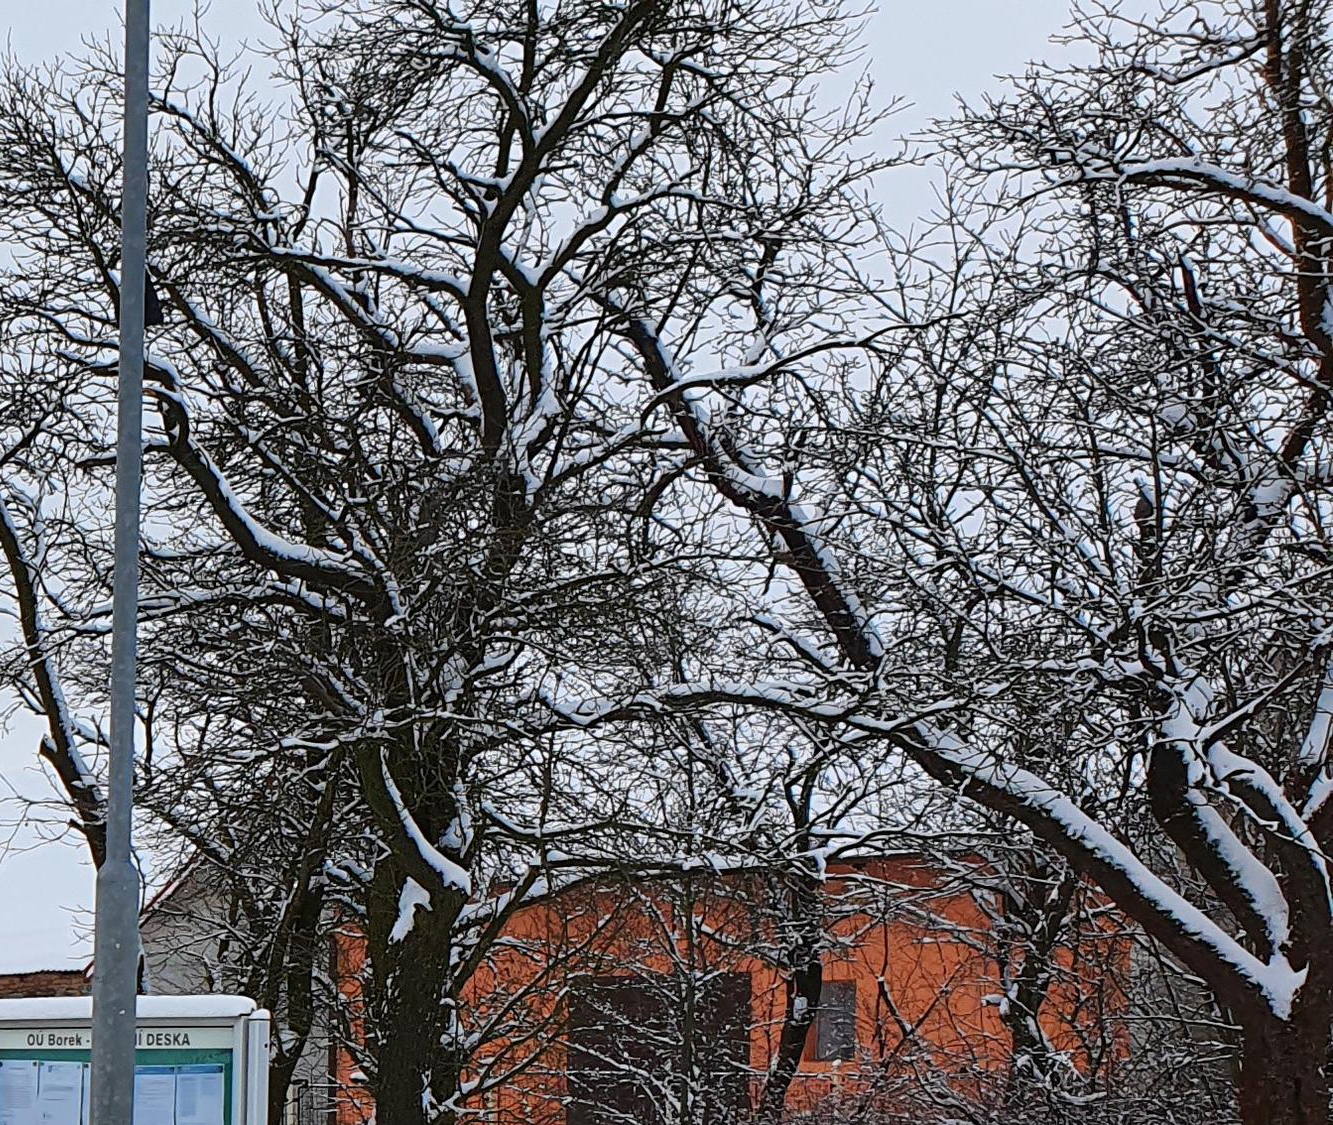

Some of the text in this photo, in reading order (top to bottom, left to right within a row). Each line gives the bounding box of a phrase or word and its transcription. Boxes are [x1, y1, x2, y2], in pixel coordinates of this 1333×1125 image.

[27, 1030, 44, 1046] OÚ
[48, 1033, 82, 1046] Borek
[146, 1032, 191, 1046] DESKA
